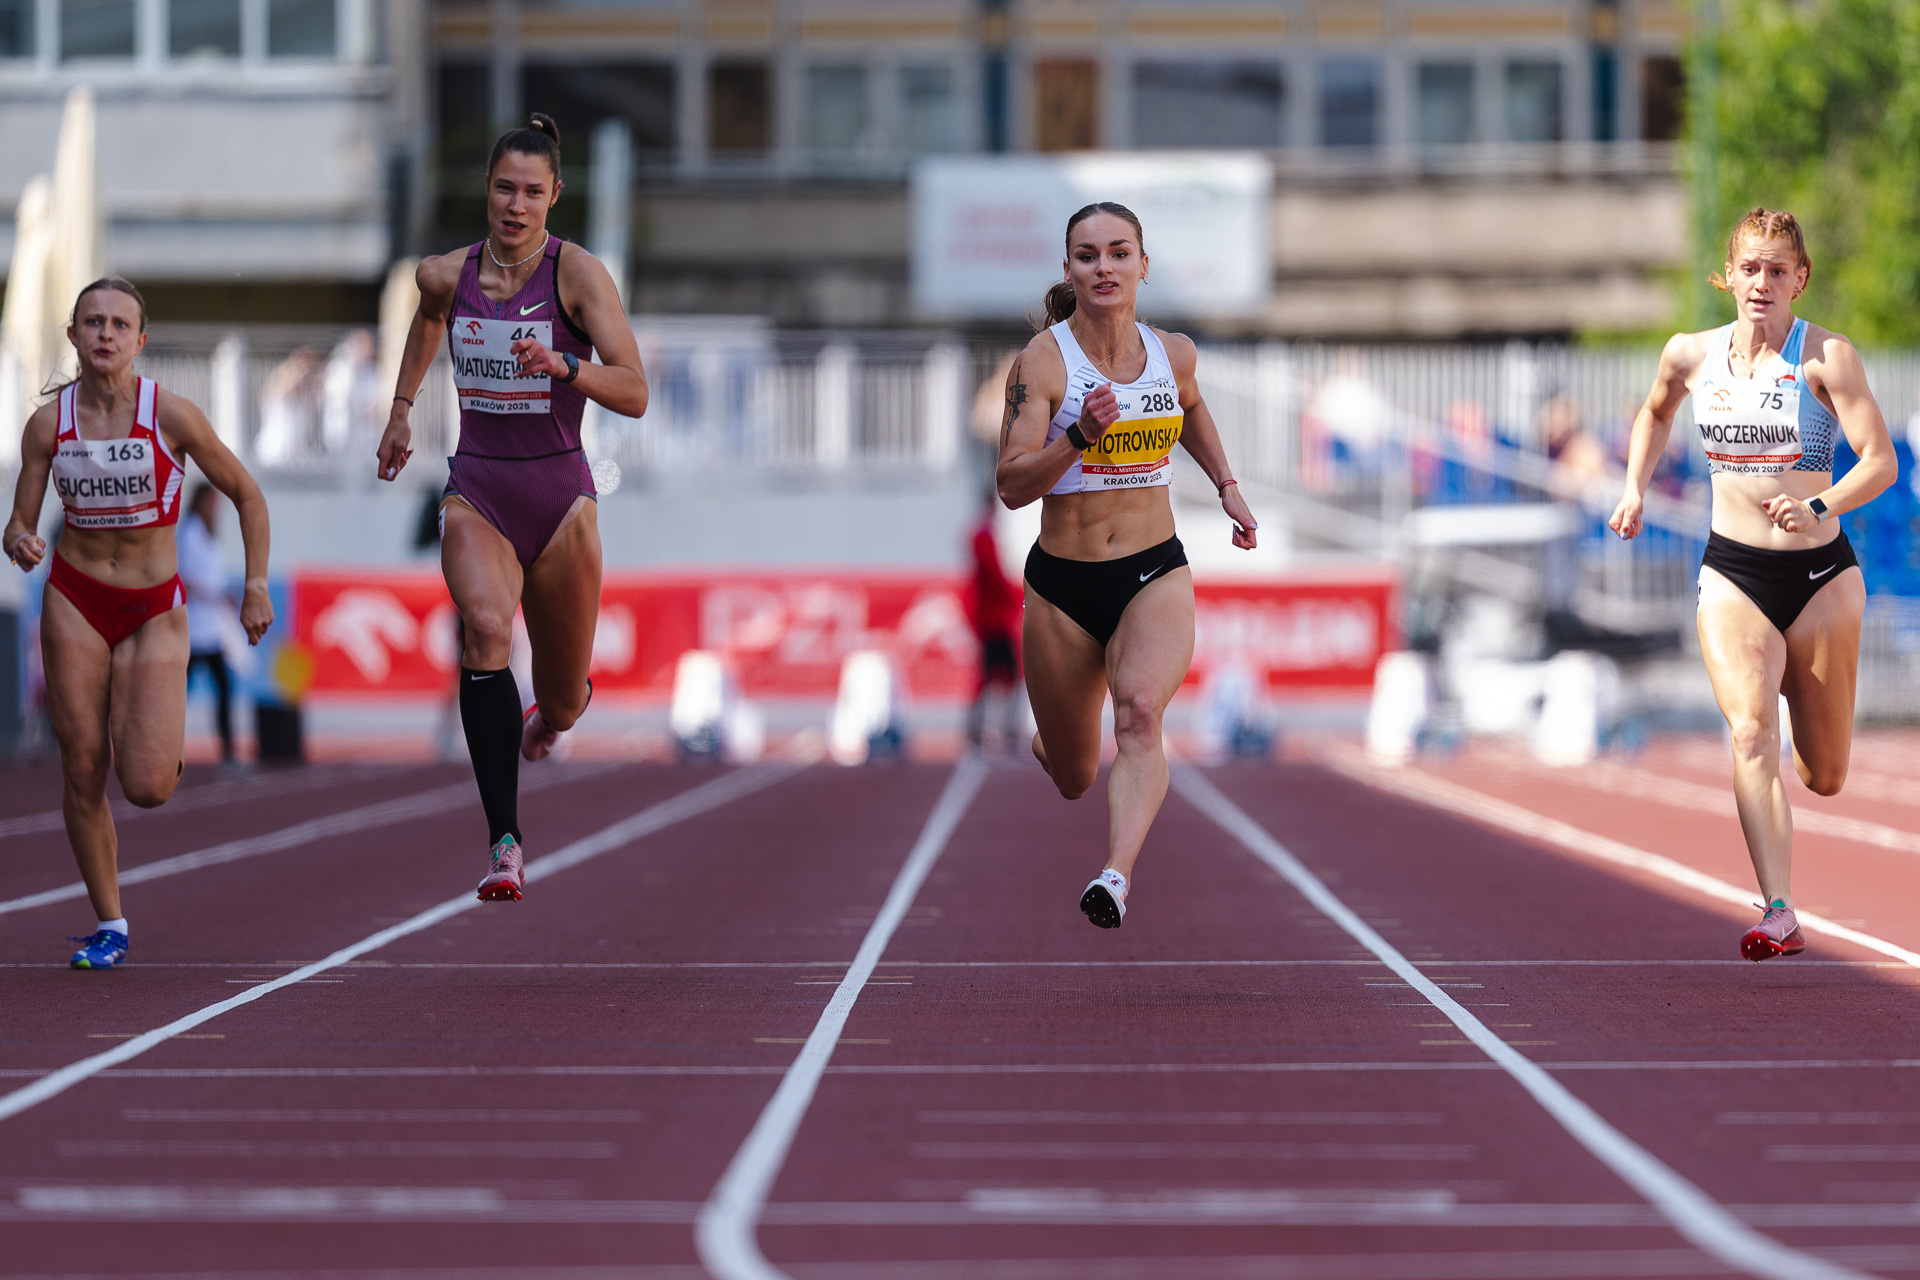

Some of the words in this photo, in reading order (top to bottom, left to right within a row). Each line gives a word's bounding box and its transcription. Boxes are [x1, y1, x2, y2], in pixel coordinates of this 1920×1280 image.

[462, 337, 485, 346] ORLEN
[456, 356, 548, 380] MATUSZEW
[470, 399, 505, 411] KRAKÓW
[507, 402, 530, 410] 2025
[1140, 393, 1174, 413] 288
[1760, 392, 1783, 410] 75
[1087, 428, 1178, 454] PIOTROWSKA
[1699, 424, 1798, 444] MOCZERNIUK
[107, 444, 144, 462] 163
[1721, 463, 1760, 473] KRAKÓW
[1762, 465, 1784, 473] 2025
[58, 474, 152, 498] SUCHENEK
[1104, 474, 1148, 486] KRAKÓW
[76, 516, 115, 526] KRAKÓW
[118, 515, 140, 525] 2025
